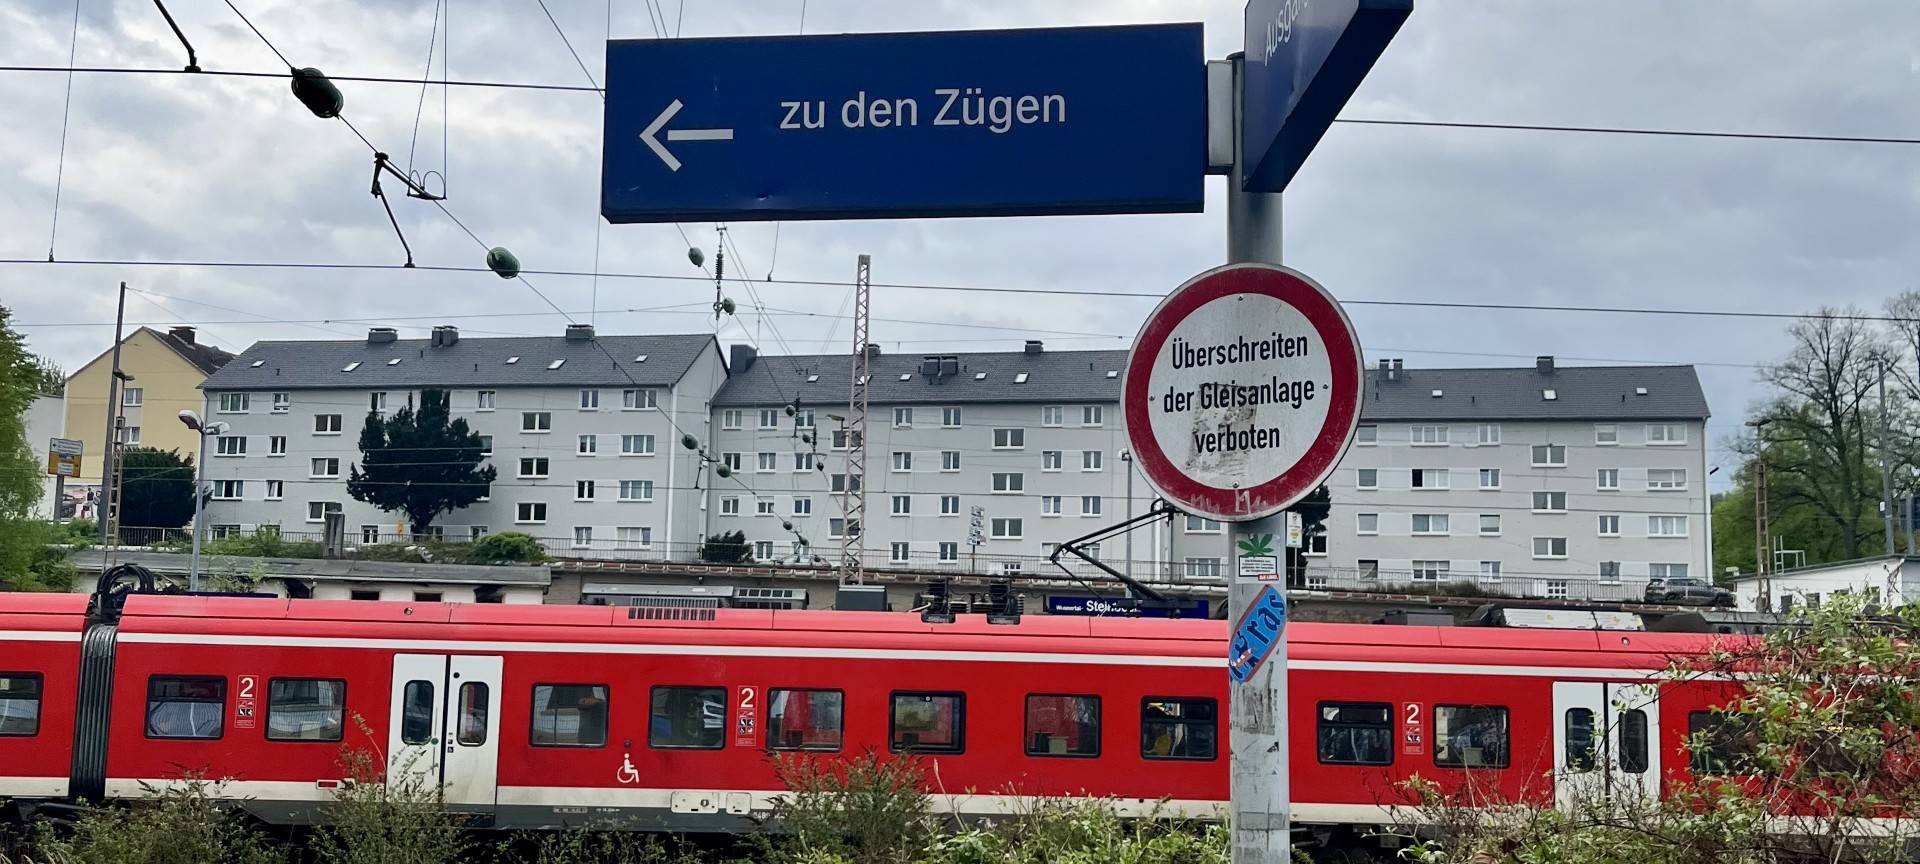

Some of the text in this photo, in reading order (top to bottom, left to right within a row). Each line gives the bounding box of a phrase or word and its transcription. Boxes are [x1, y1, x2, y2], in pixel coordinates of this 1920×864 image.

[1264, 0, 1308, 67] Ausga
[779, 88, 1066, 133] zu den Zügen
[1172, 332, 1308, 369] Überschreiten
[1164, 375, 1315, 413] der Gleisanlage
[1195, 424, 1280, 453] verboten
[240, 677, 254, 697] 2
[741, 688, 754, 708] 2
[1406, 704, 1419, 724] 2
